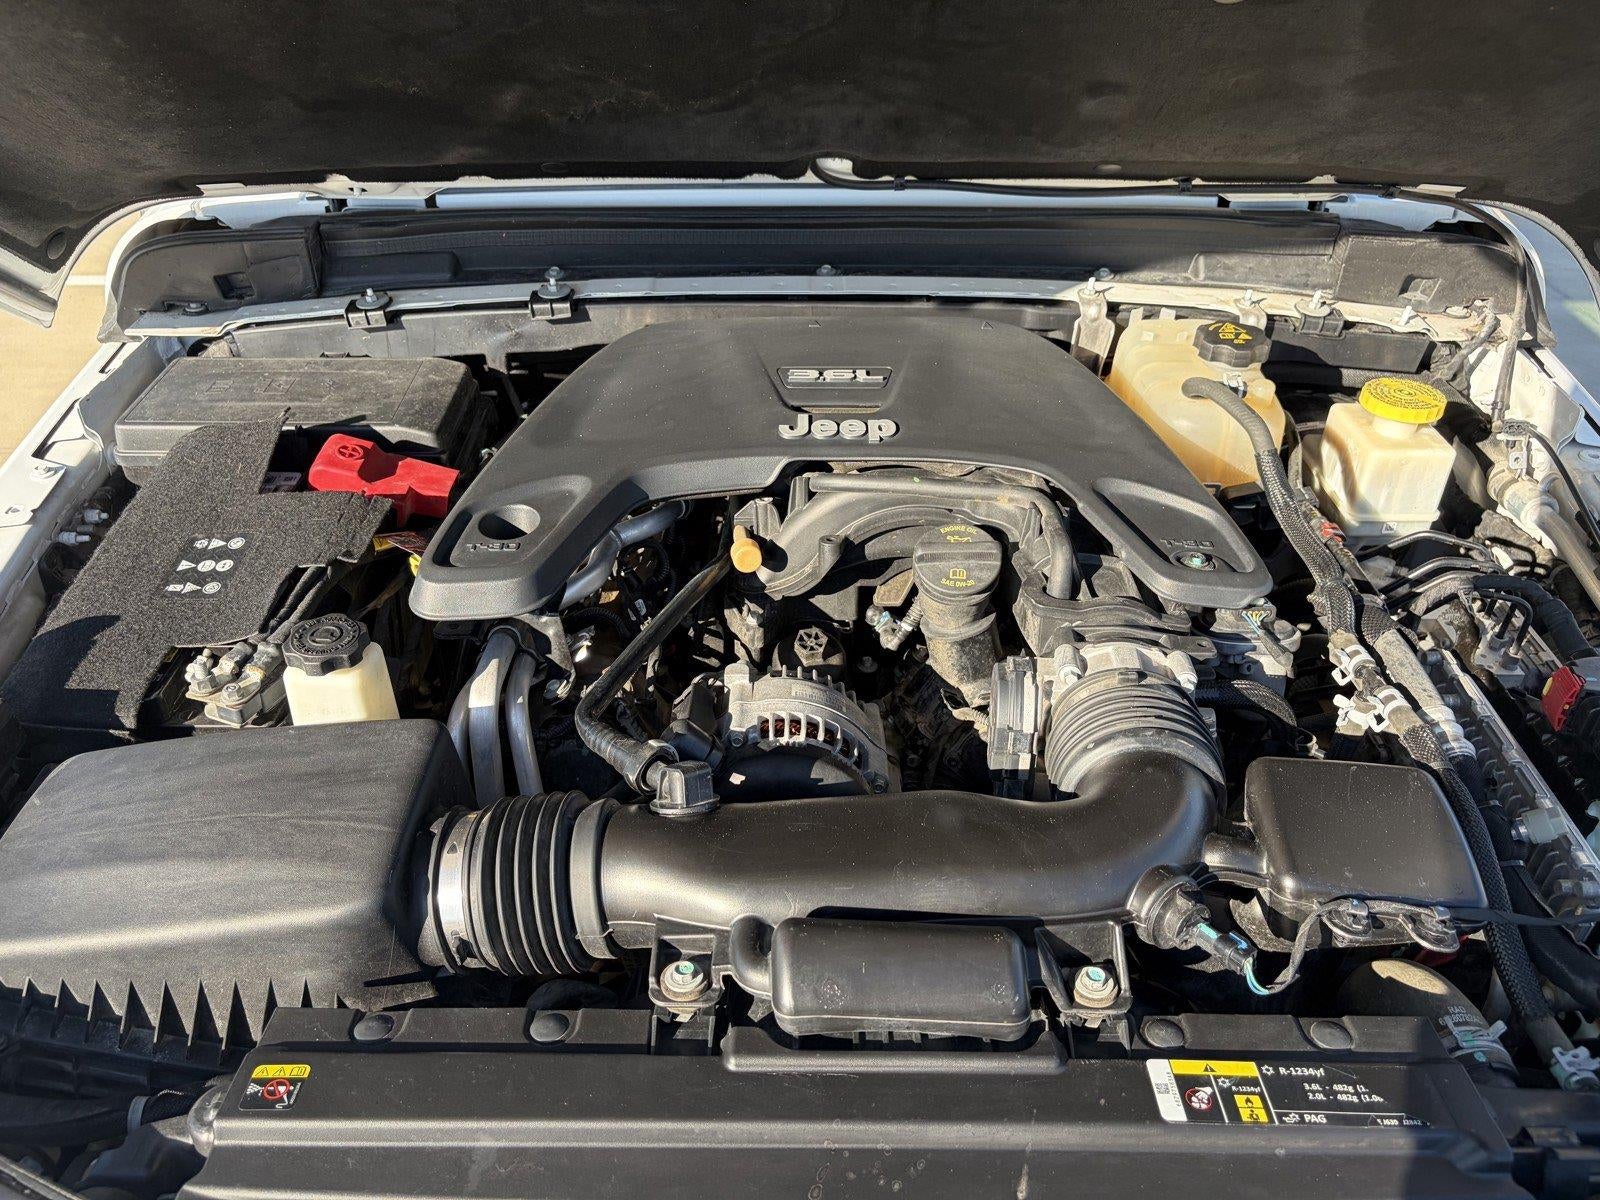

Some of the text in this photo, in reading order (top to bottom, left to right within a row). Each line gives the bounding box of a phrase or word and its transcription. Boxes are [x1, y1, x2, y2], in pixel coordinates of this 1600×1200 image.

[787, 369, 884, 382] 3.6L
[778, 413, 899, 443] Jeep
[940, 525, 978, 535] ENGINE OIL
[466, 542, 521, 551] T-30
[1160, 539, 1215, 549] T-30
[940, 577, 955, 587] SAE
[1279, 1066, 1325, 1078] R-1234yf
[1303, 1083, 1323, 1091] 3.6L
[1332, 1084, 1355, 1093] 482g
[1307, 1092, 1327, 1100] 2.0L
[1337, 1093, 1359, 1103] 482g
[1304, 1114, 1328, 1124] PAG
